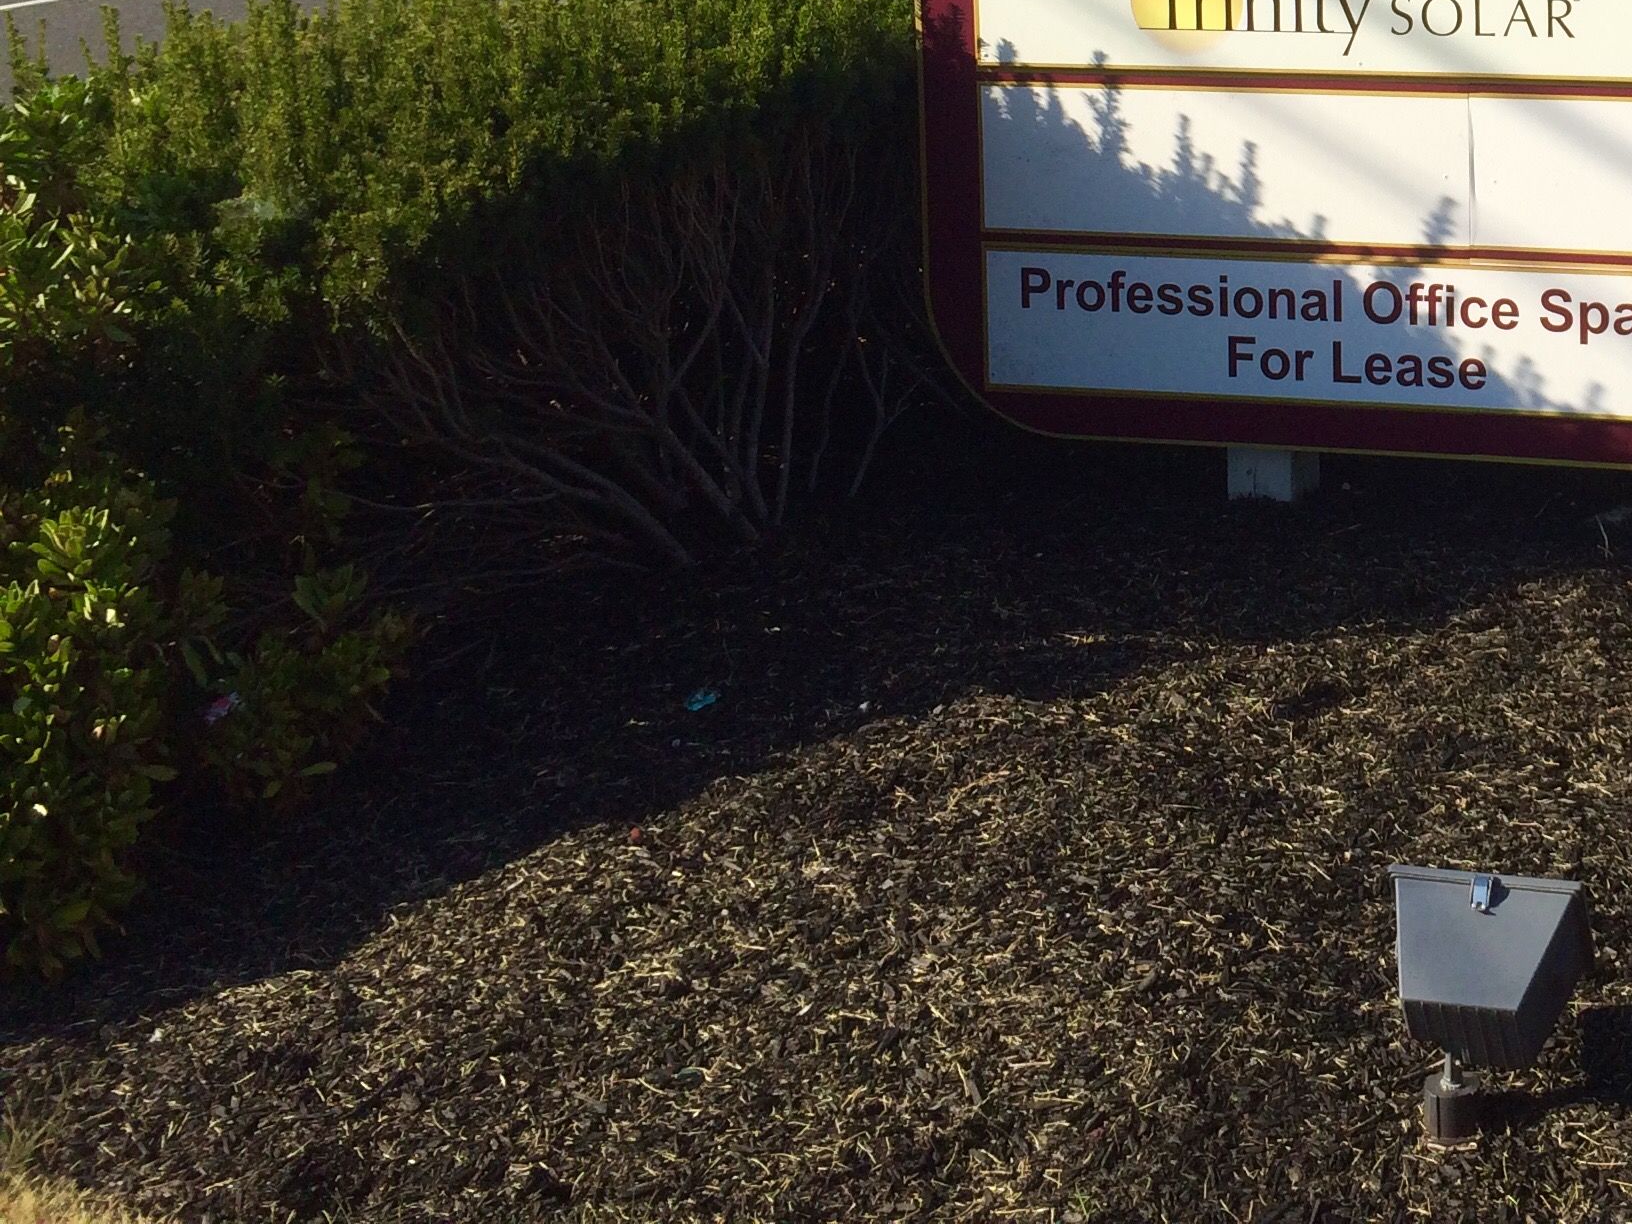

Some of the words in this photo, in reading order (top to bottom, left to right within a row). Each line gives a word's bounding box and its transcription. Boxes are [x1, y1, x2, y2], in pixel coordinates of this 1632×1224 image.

[1020, 265, 1343, 323] Professional
[1362, 280, 1519, 330] Office
[1228, 335, 1313, 380] For
[1333, 340, 1488, 391] Lease
